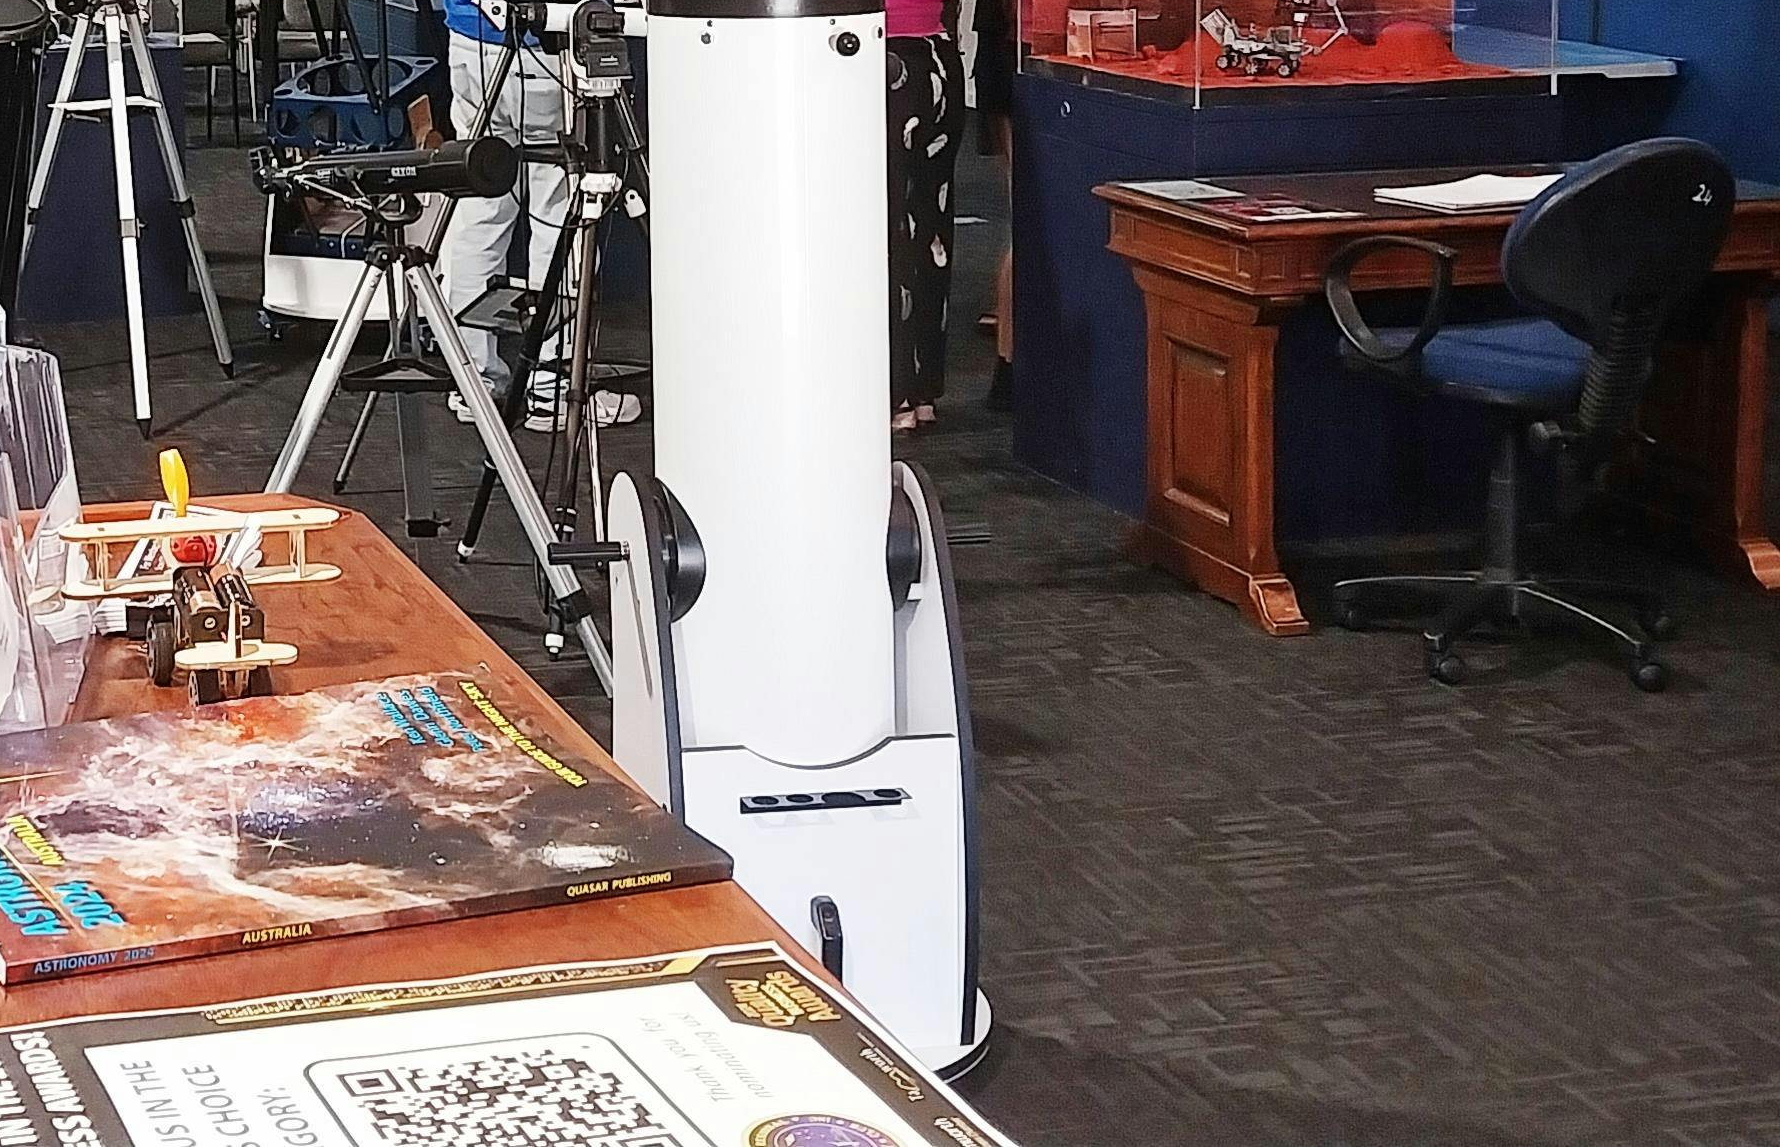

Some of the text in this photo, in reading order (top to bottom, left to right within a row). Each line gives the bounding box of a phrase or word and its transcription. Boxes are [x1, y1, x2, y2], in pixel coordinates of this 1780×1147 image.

[1692, 183, 1713, 206] 24
[376, 691, 426, 746] Ken Wallace
[399, 688, 455, 749] Glenn Dawes
[419, 685, 464, 733] Northfield
[458, 680, 590, 789] YOUR GUIDE TO THE NIGHT SKY
[4, 814, 66, 867] AUSTRALIA
[51, 880, 127, 930] 2024
[566, 871, 672, 898] QUASAR PUBLISHING
[242, 923, 312, 945] AUSTRALIA
[33, 947, 156, 975] ASTRONOMY 2024
[724, 978, 798, 1027] Quality
[765, 969, 843, 1023] Awards
[9, 1030, 87, 1115] AWARDS!
[119, 1060, 158, 1097] THE
[640, 1015, 736, 1103] Thank you for
[696, 1030, 774, 1100] nominating
[140, 1096, 182, 1119] IN
[181, 1062, 253, 1139] CHOICE
